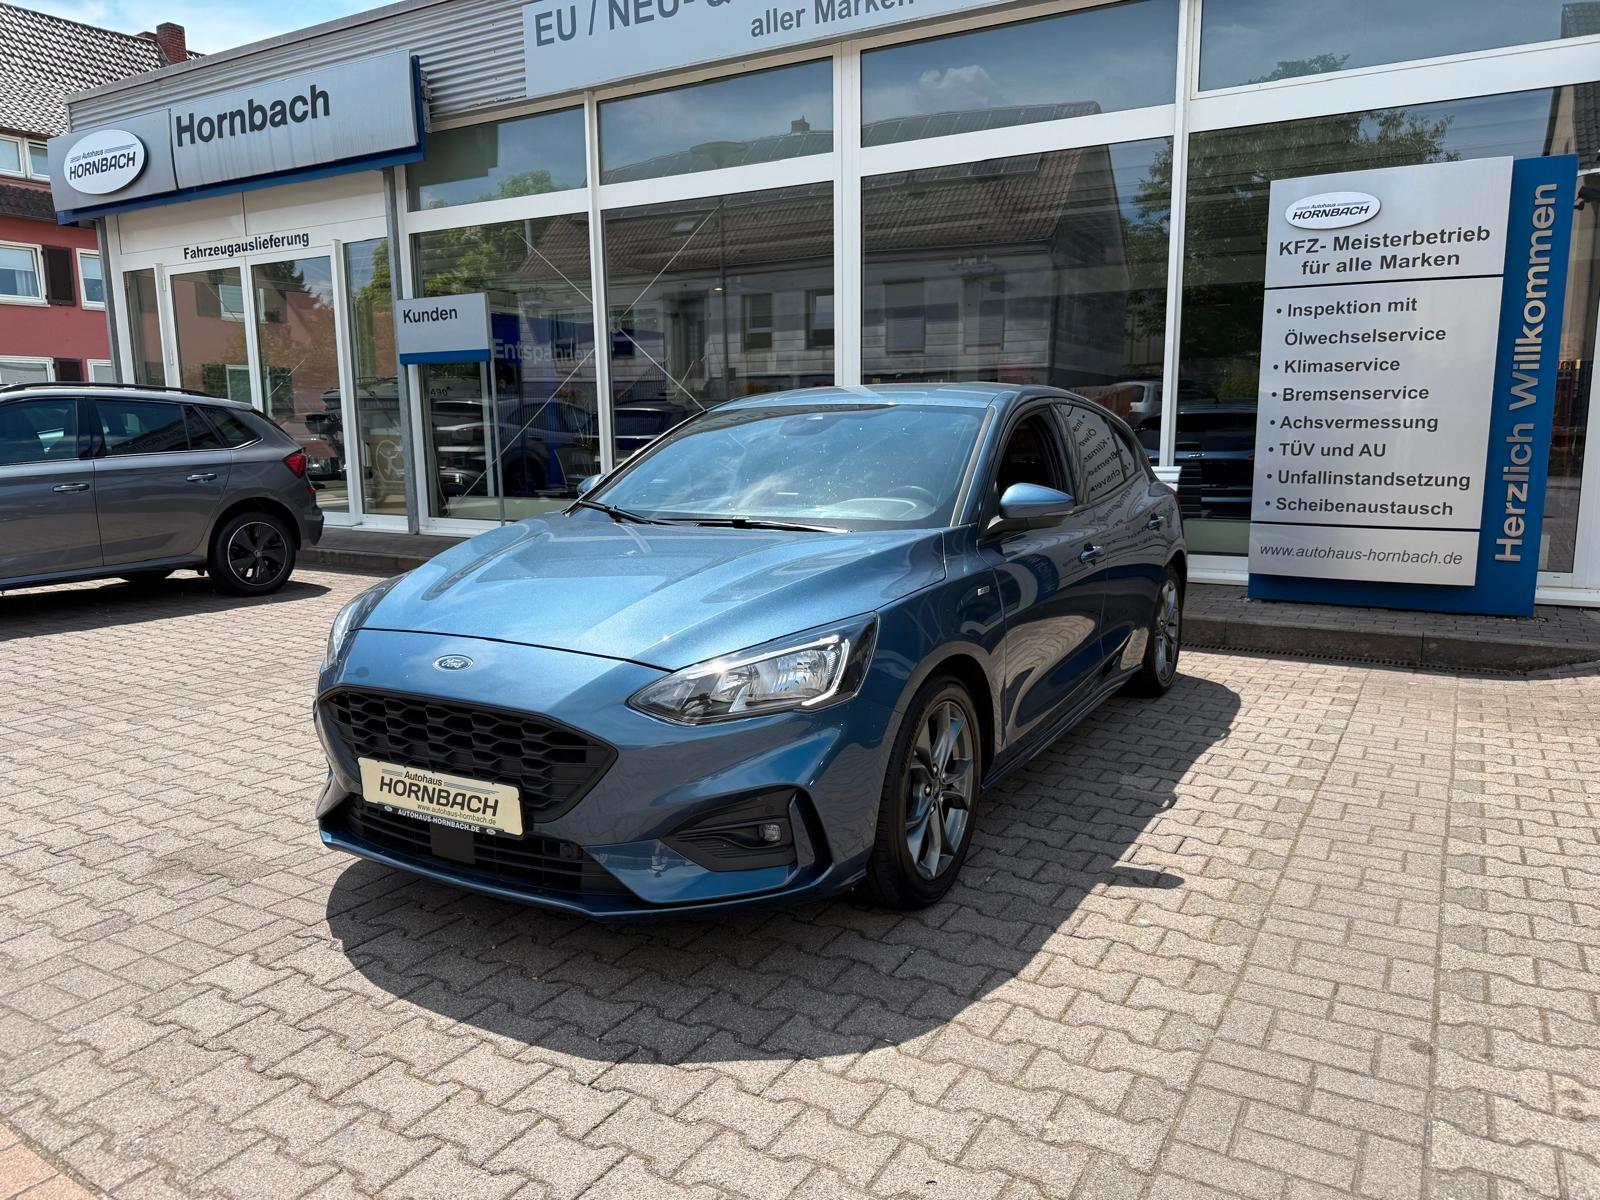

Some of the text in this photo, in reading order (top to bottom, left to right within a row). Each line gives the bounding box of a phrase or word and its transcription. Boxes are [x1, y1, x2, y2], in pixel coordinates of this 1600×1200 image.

[534, 10, 577, 47] EU
[588, 5, 596, 36] /
[750, 8, 806, 38] aller
[175, 84, 330, 147] Hornbach
[82, 149, 104, 160] Autohaus
[69, 151, 136, 181] HORNBACH
[1292, 205, 1370, 220] HORNBACH
[183, 231, 310, 261] Fahrzeugauslieferung
[1279, 225, 1490, 256] KFZ- Meisterbetrieb
[1301, 251, 1460, 275] für alle Marken
[403, 306, 458, 324] Kunden
[1287, 298, 1418, 318] Inspektion mit
[1284, 326, 1447, 346] Ölwechselservice
[1284, 357, 1400, 374] Klimaservice
[1495, 183, 1557, 562] Herzlich Willkommen
[1282, 386, 1429, 402] Bremsenservice
[1280, 415, 1438, 432] Achsvermessung
[1280, 440, 1386, 457] TÜV und AU
[1278, 470, 1471, 491] Unfallinstandsetzung
[1276, 497, 1453, 516] Scheibenaustausch
[1259, 544, 1463, 566] www.autohaus-hornbach.de
[404, 770, 443, 787] Autohaus
[379, 775, 499, 817] HORNBACH
[397, 809, 480, 833] AUTOHAUS-HORNBACH.DE
